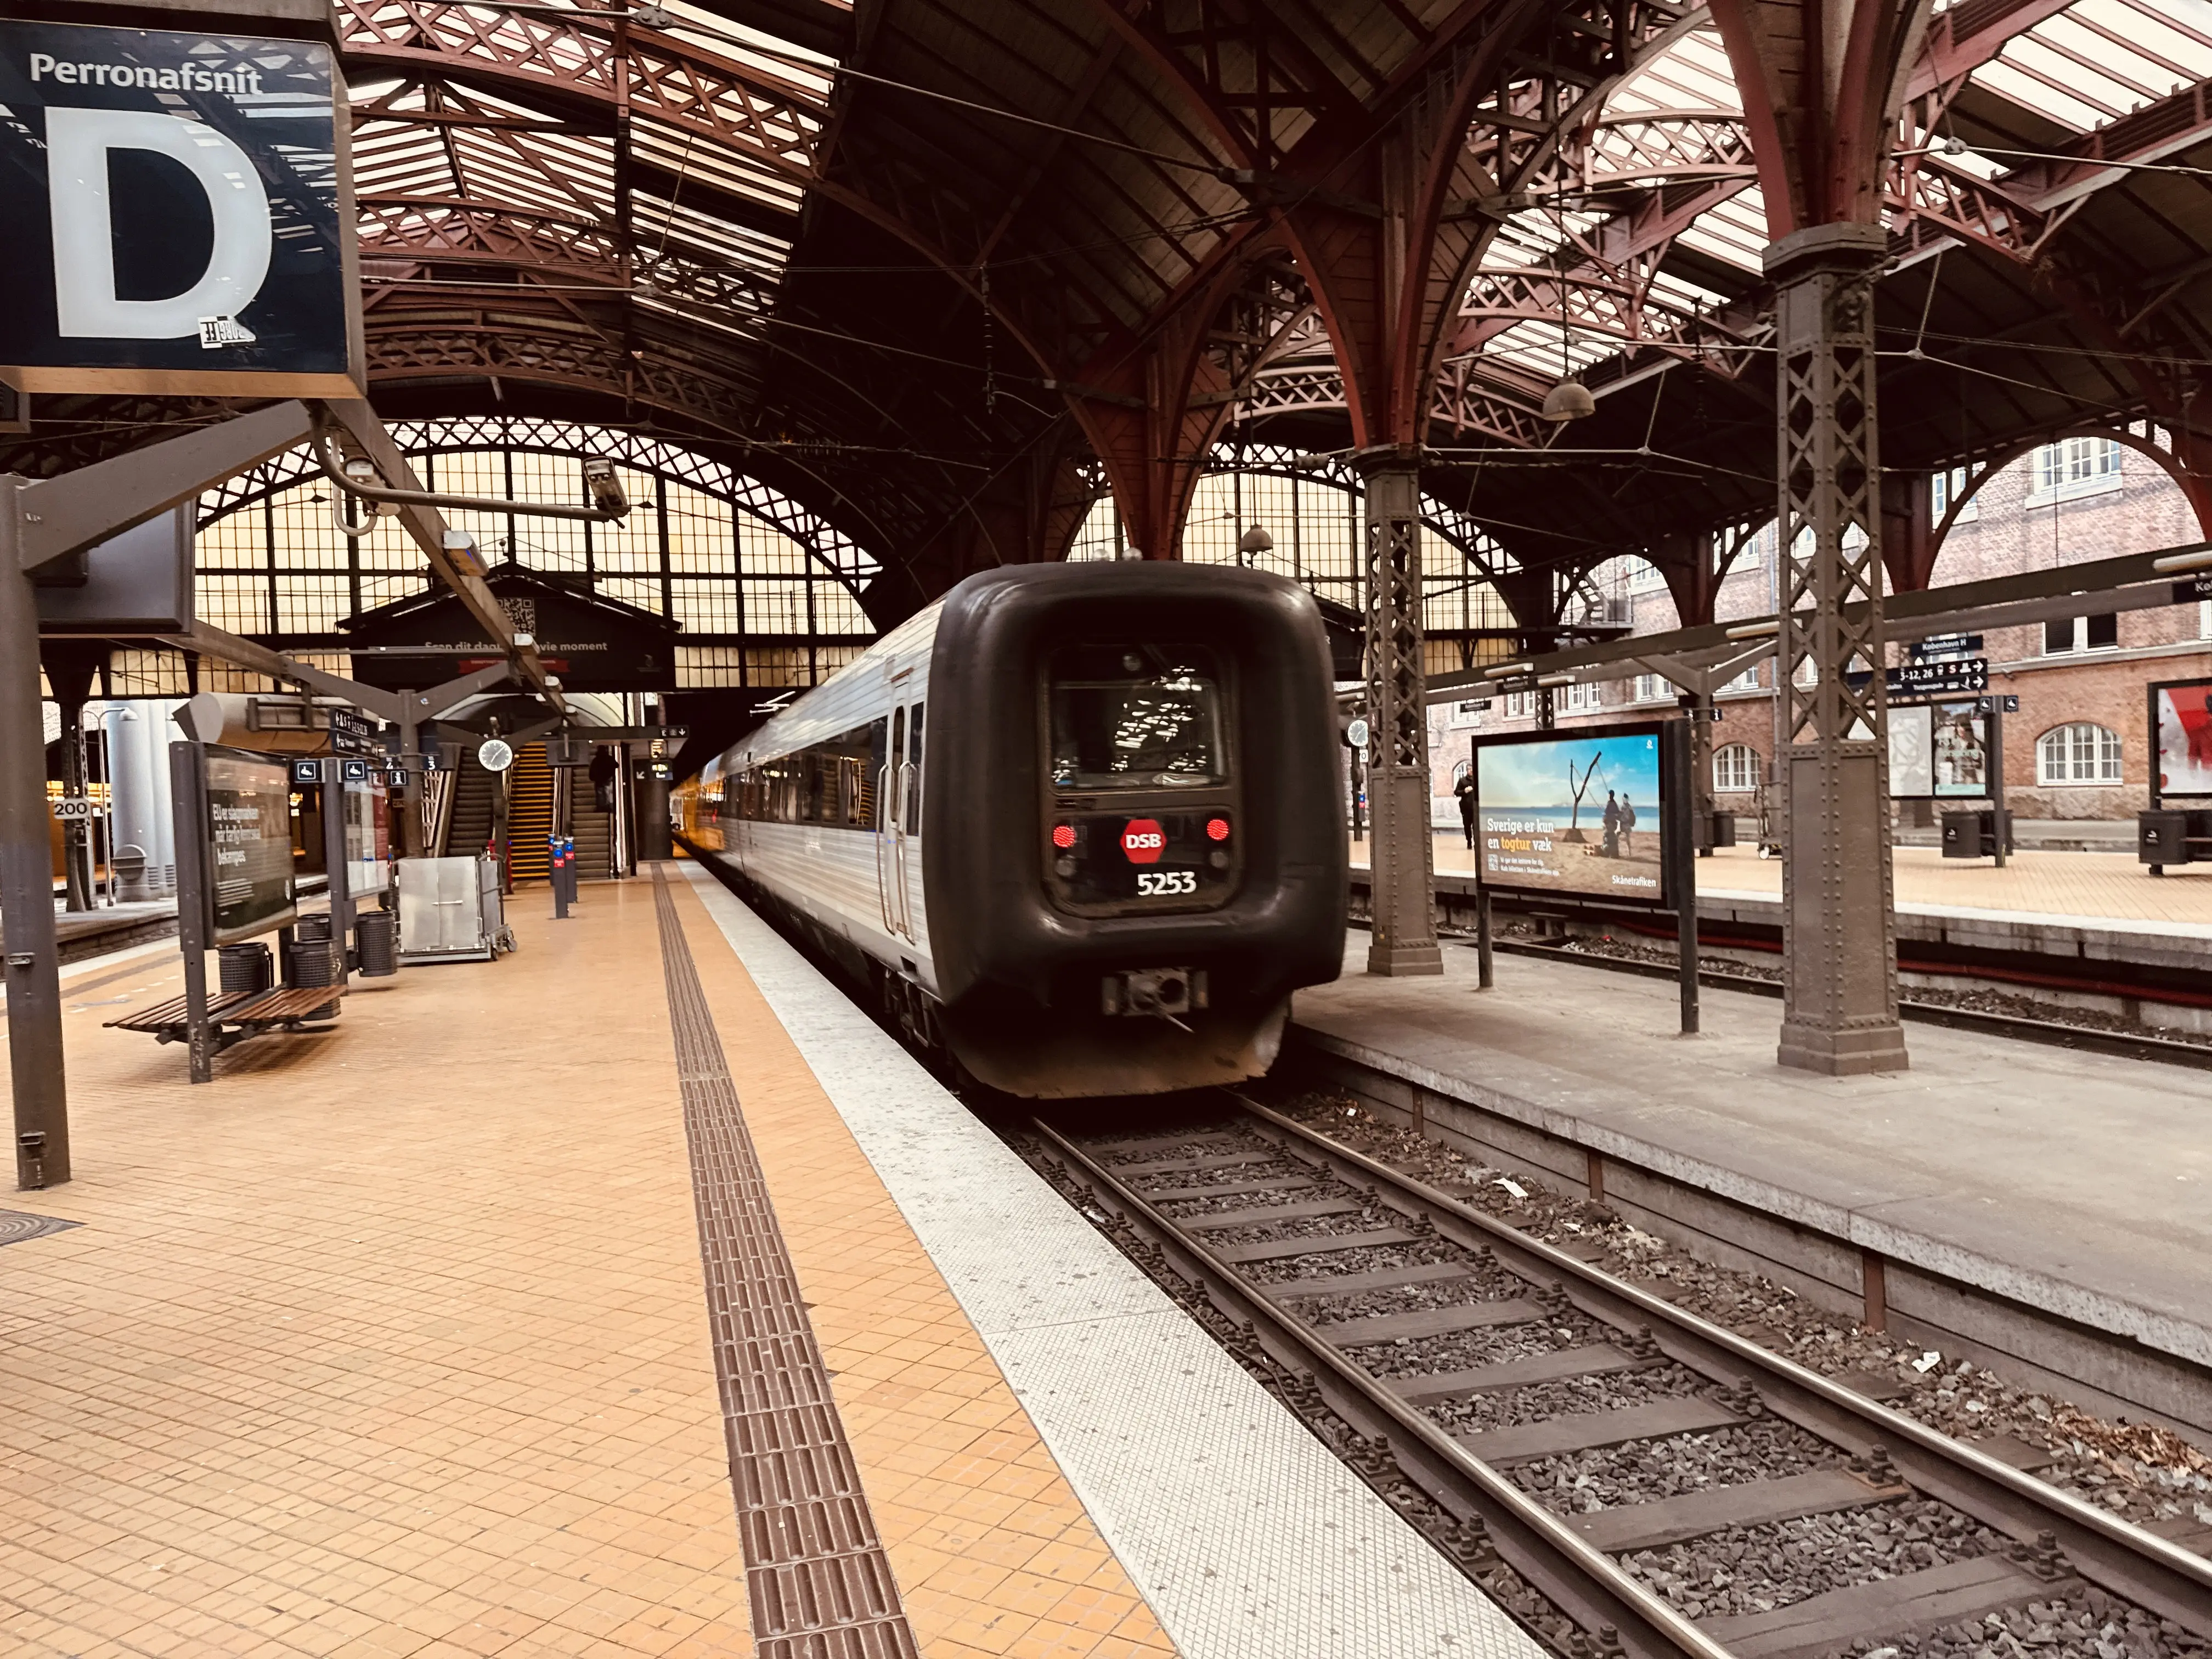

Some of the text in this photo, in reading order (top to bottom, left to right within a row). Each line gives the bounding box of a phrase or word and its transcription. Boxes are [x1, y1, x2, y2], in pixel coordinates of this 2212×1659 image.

[30, 53, 263, 95] Perronafsnit
[44, 106, 272, 339] D
[560, 642, 608, 651] moment
[1923, 668, 1933, 678] 26
[428, 761, 436, 770] 3
[54, 803, 87, 815] 200
[1487, 817, 1554, 835] Sverige er kun
[1126, 833, 1161, 849] DSB
[1488, 836, 1552, 853] en togtur væk
[1137, 871, 1197, 896] 5253
[1612, 874, 1656, 887] Skånetrafiken
